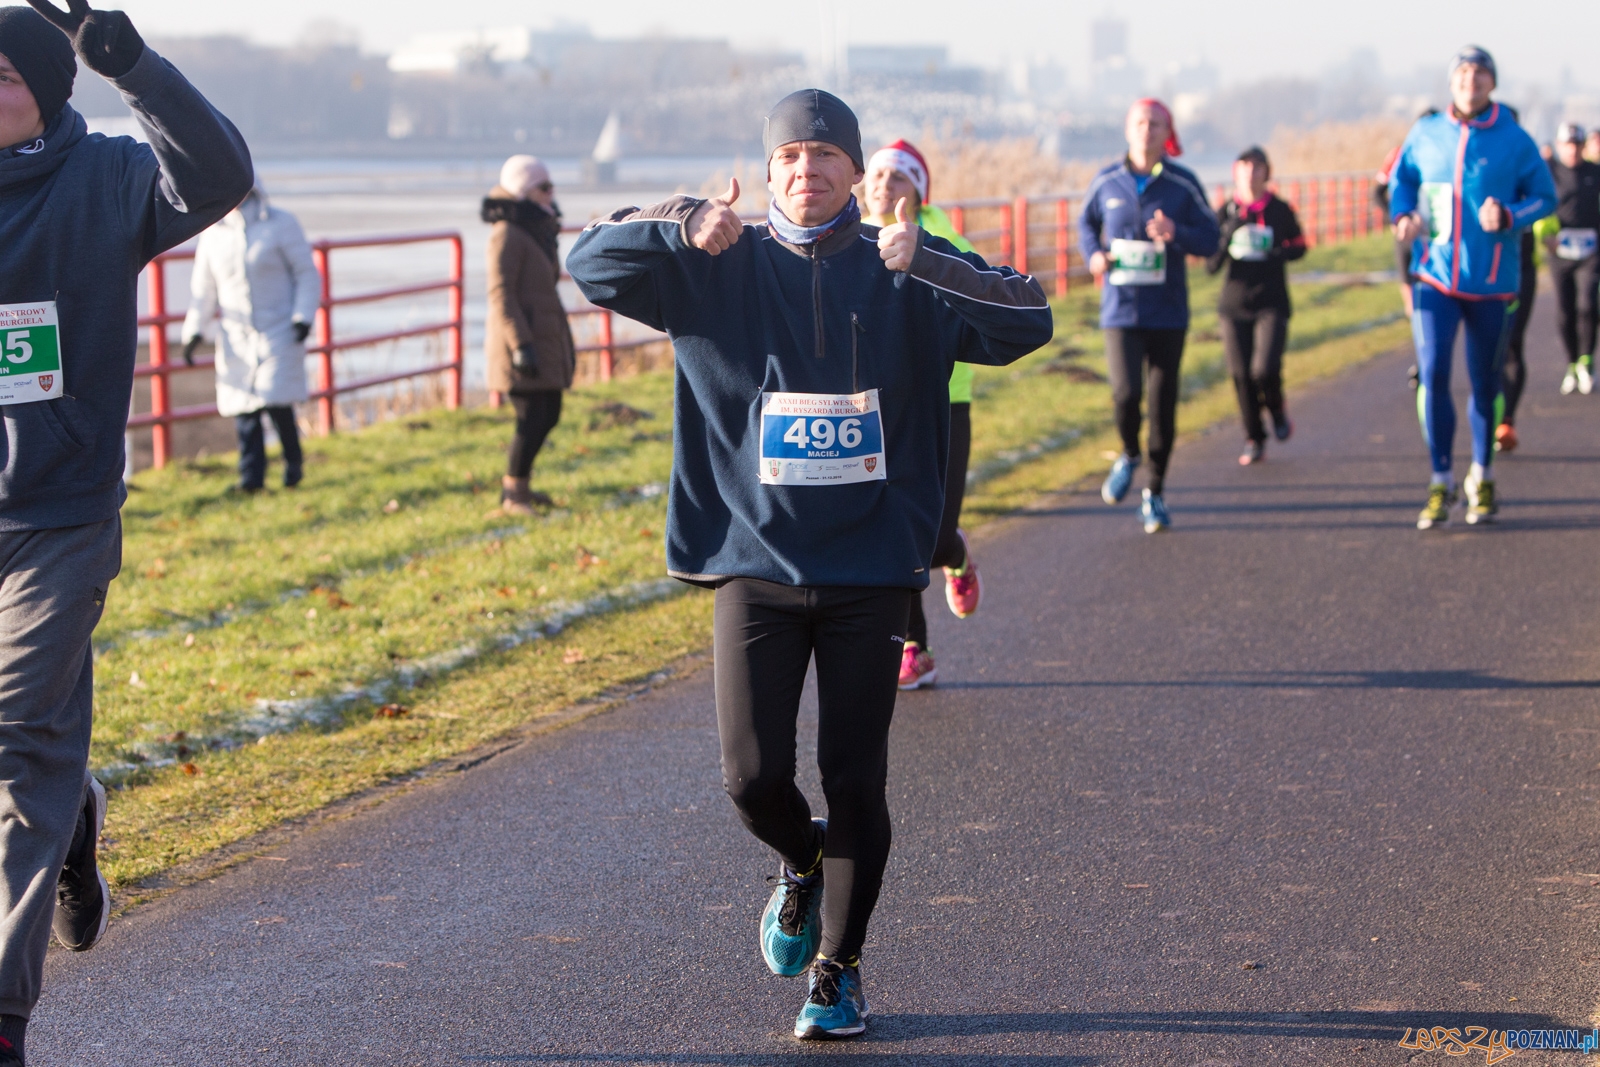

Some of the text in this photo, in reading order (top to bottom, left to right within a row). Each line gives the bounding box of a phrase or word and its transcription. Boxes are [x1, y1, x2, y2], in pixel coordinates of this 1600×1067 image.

[0, 330, 33, 364] 5
[818, 396, 870, 406] SYLWESTROWY
[780, 406, 792, 414] IM.
[793, 407, 833, 415] RYSZARDA
[783, 417, 863, 450] 496
[807, 450, 840, 458] MACIEJ
